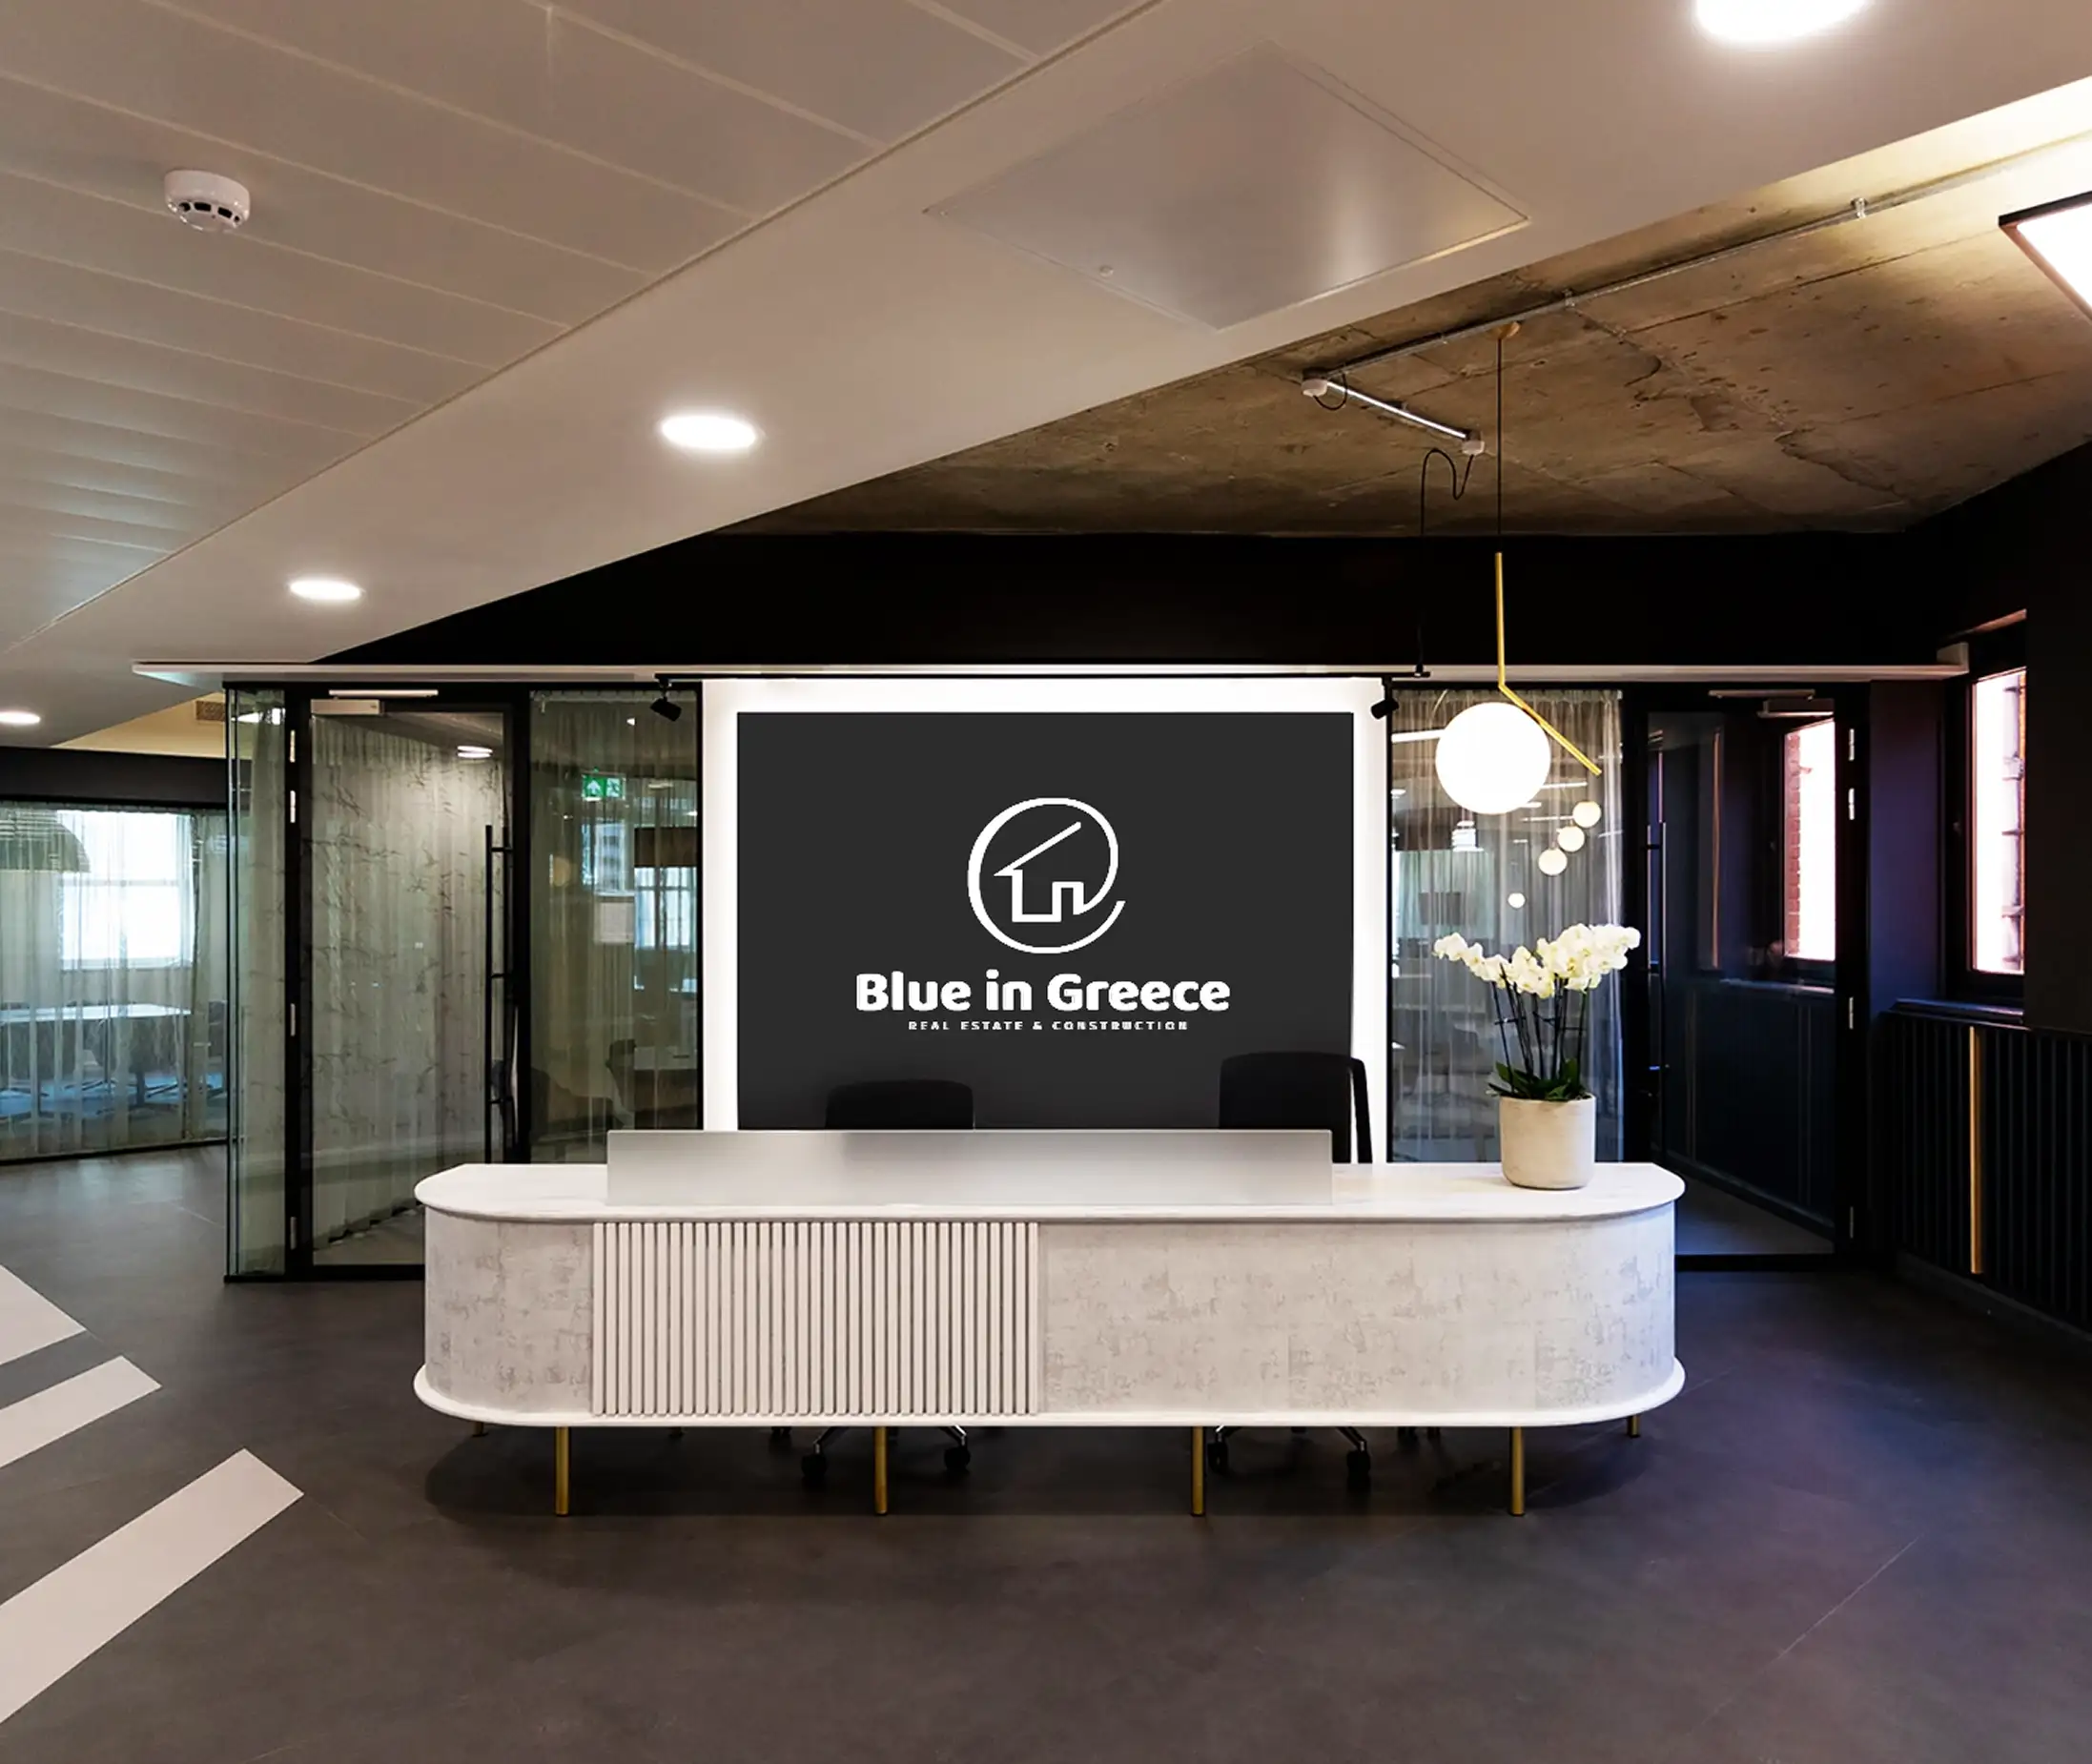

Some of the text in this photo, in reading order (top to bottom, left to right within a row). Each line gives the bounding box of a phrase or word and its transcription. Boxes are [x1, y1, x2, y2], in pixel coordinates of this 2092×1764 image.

[855, 968, 1231, 1012] Blue in Greece
[908, 1020, 1188, 1031] REAL ESTATE & CONSTRUCTION
